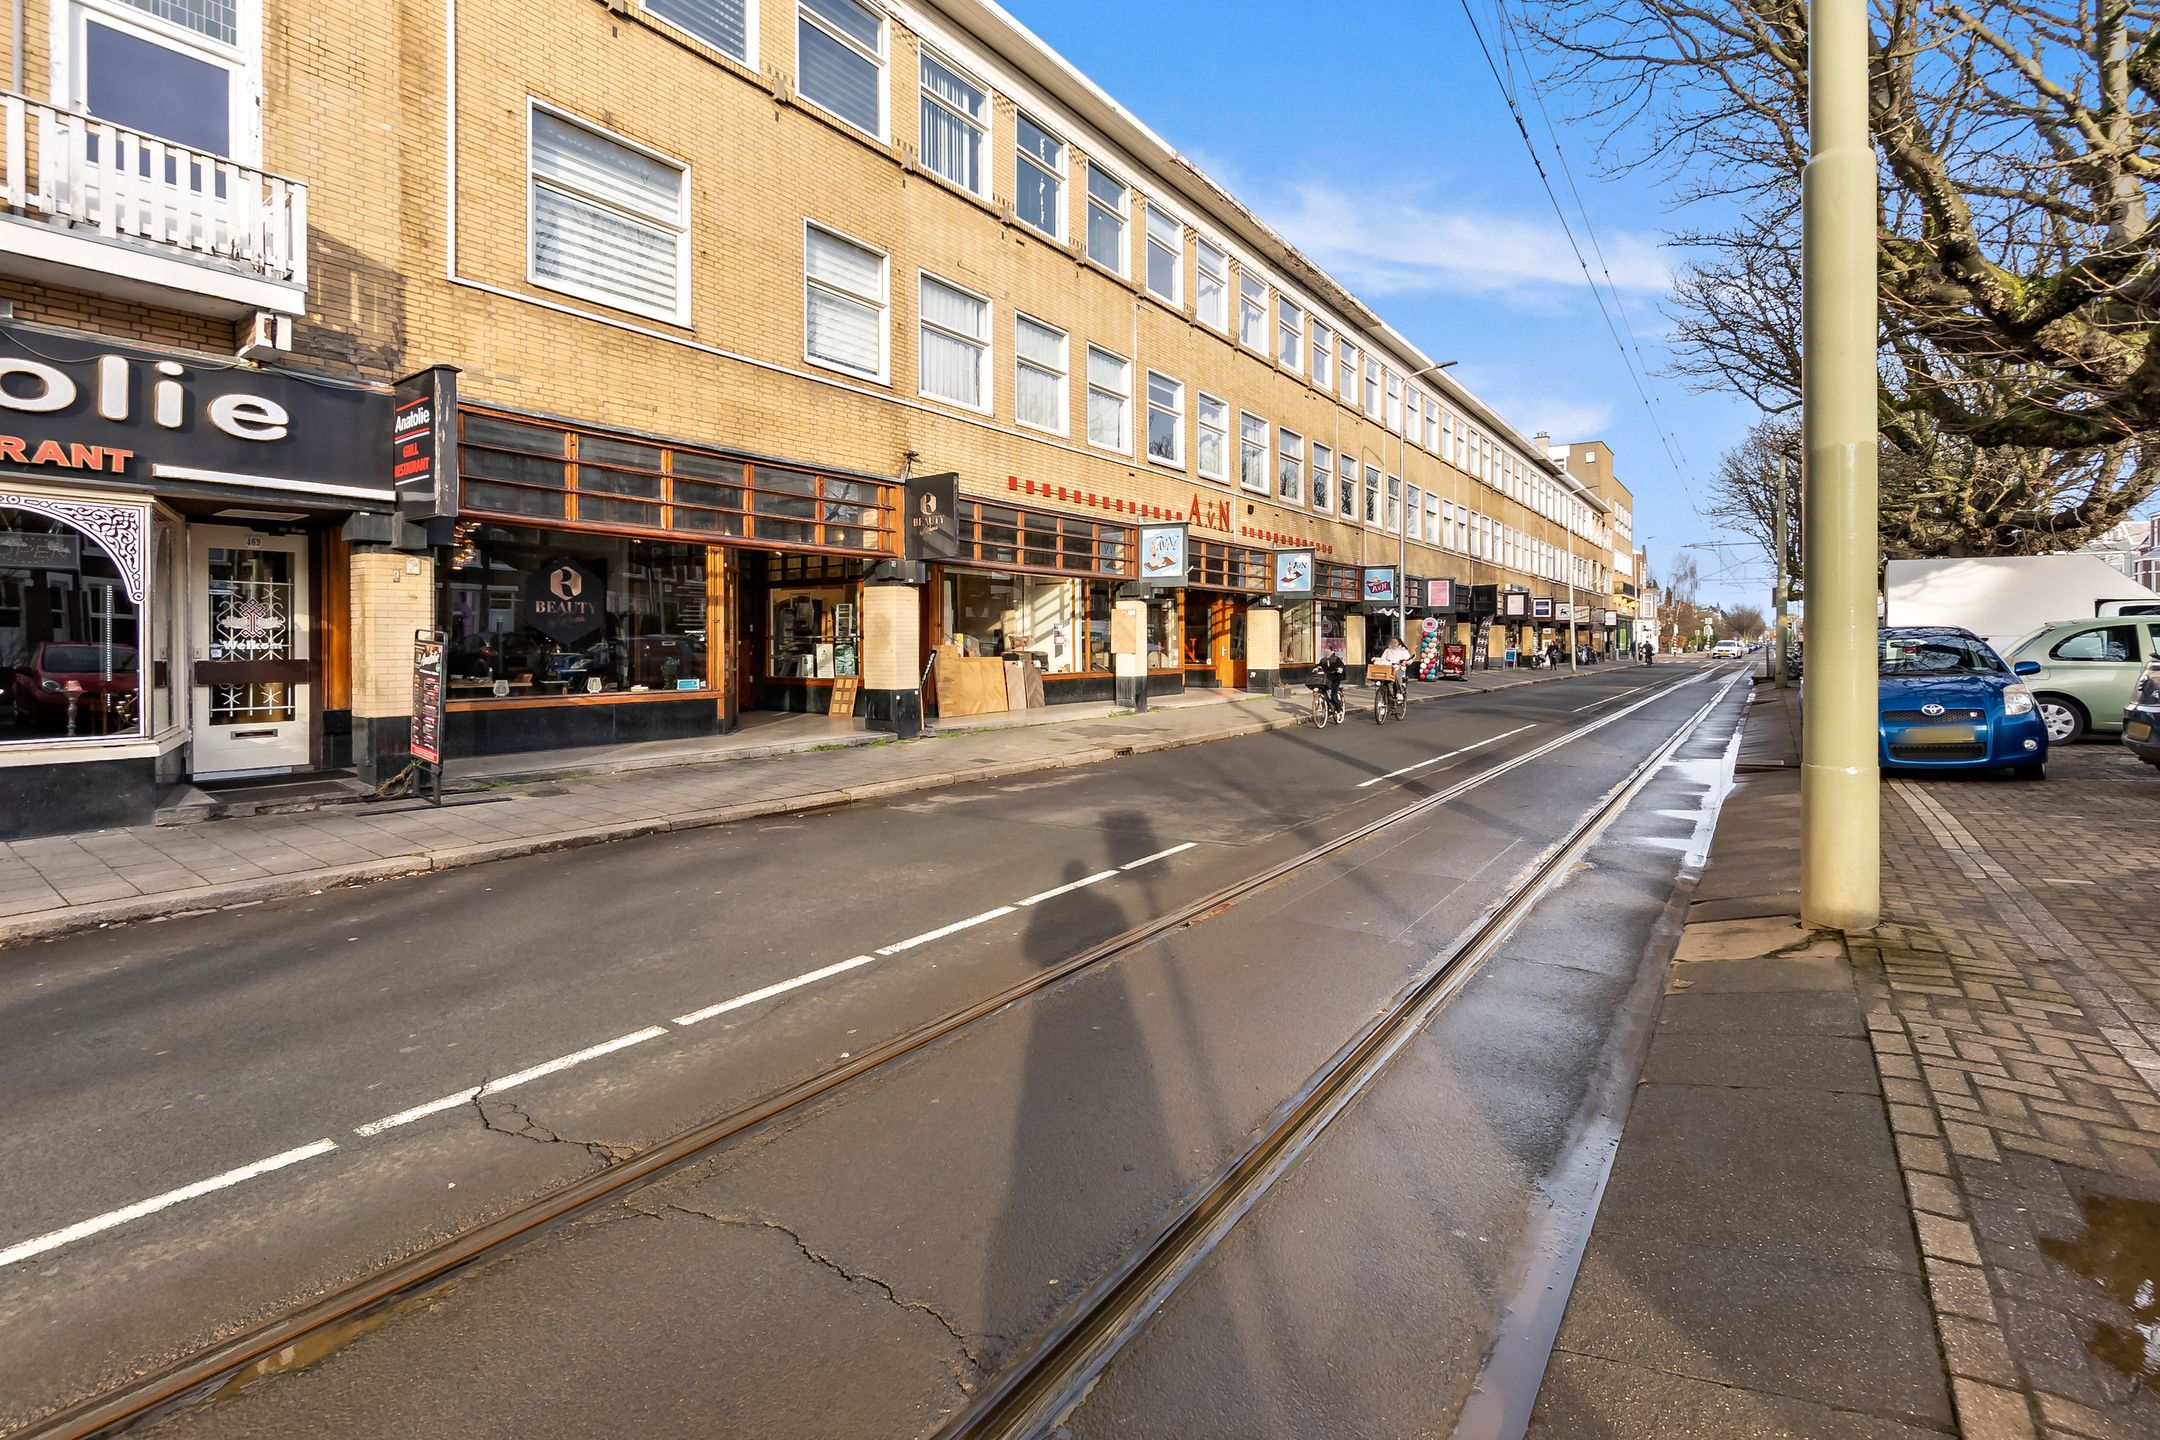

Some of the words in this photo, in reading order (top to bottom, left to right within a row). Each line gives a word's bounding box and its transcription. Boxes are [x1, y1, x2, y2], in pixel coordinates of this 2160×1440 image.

[0, 354, 289, 441] olie
[395, 407, 430, 433] Anatolie
[0, 435, 133, 473] RANT
[913, 514, 945, 527] BEAUTY
[535, 600, 597, 615] BEAUTY
[221, 640, 282, 649] Welkom
